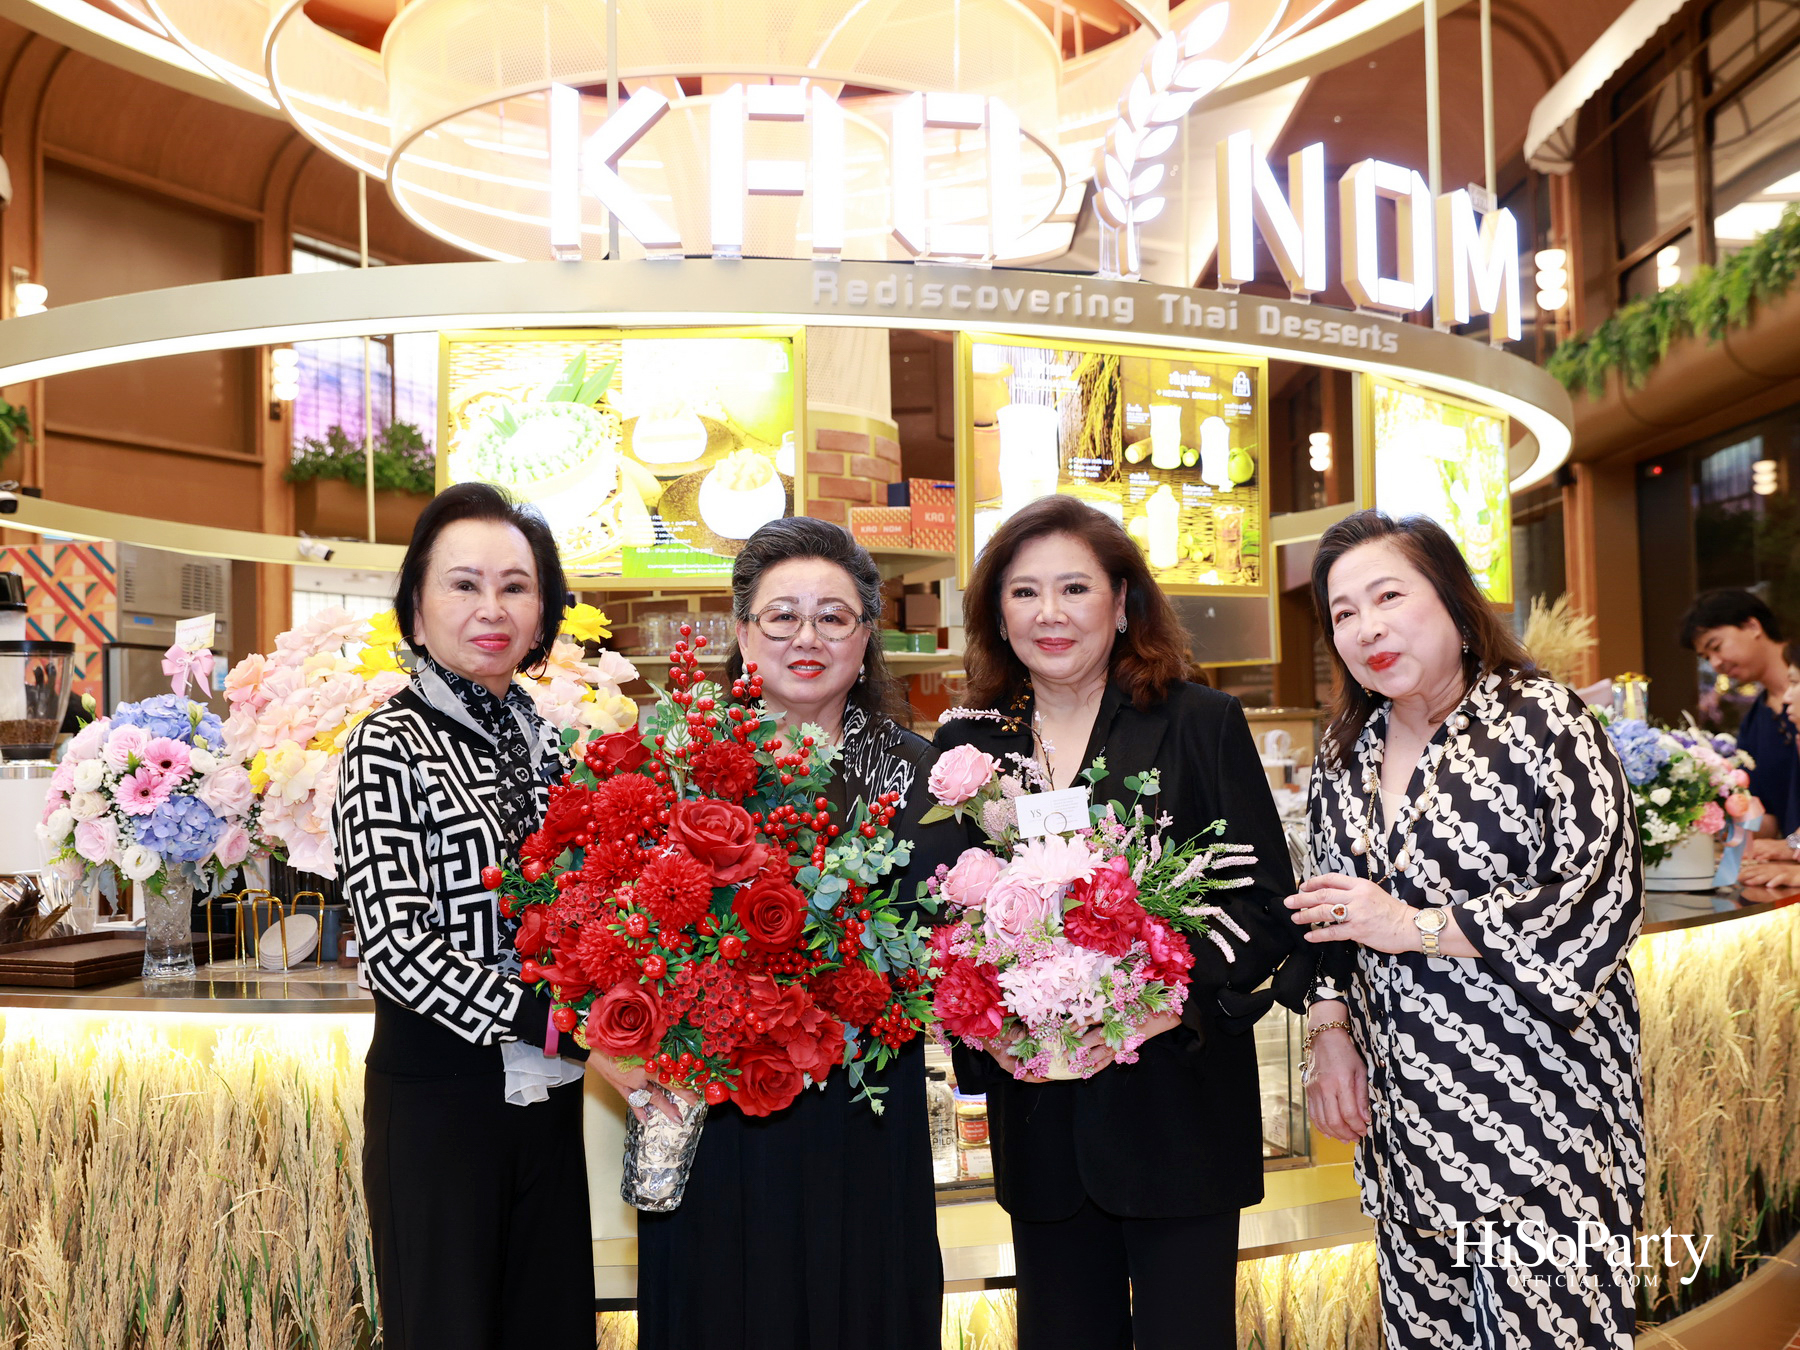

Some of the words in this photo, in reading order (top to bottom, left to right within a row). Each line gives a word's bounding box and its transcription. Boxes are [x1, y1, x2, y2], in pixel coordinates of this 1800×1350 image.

[550, 81, 1021, 260] KAO
[1216, 129, 1522, 343] NOM
[812, 269, 1134, 324] Rediscovering
[1158, 292, 1238, 331] Thai
[1259, 304, 1399, 354] Desserts
[924, 512, 945, 523] KAO
[860, 525, 878, 533] KAO
[883, 525, 902, 533] NOM
[1030, 808, 1042, 818] YS
